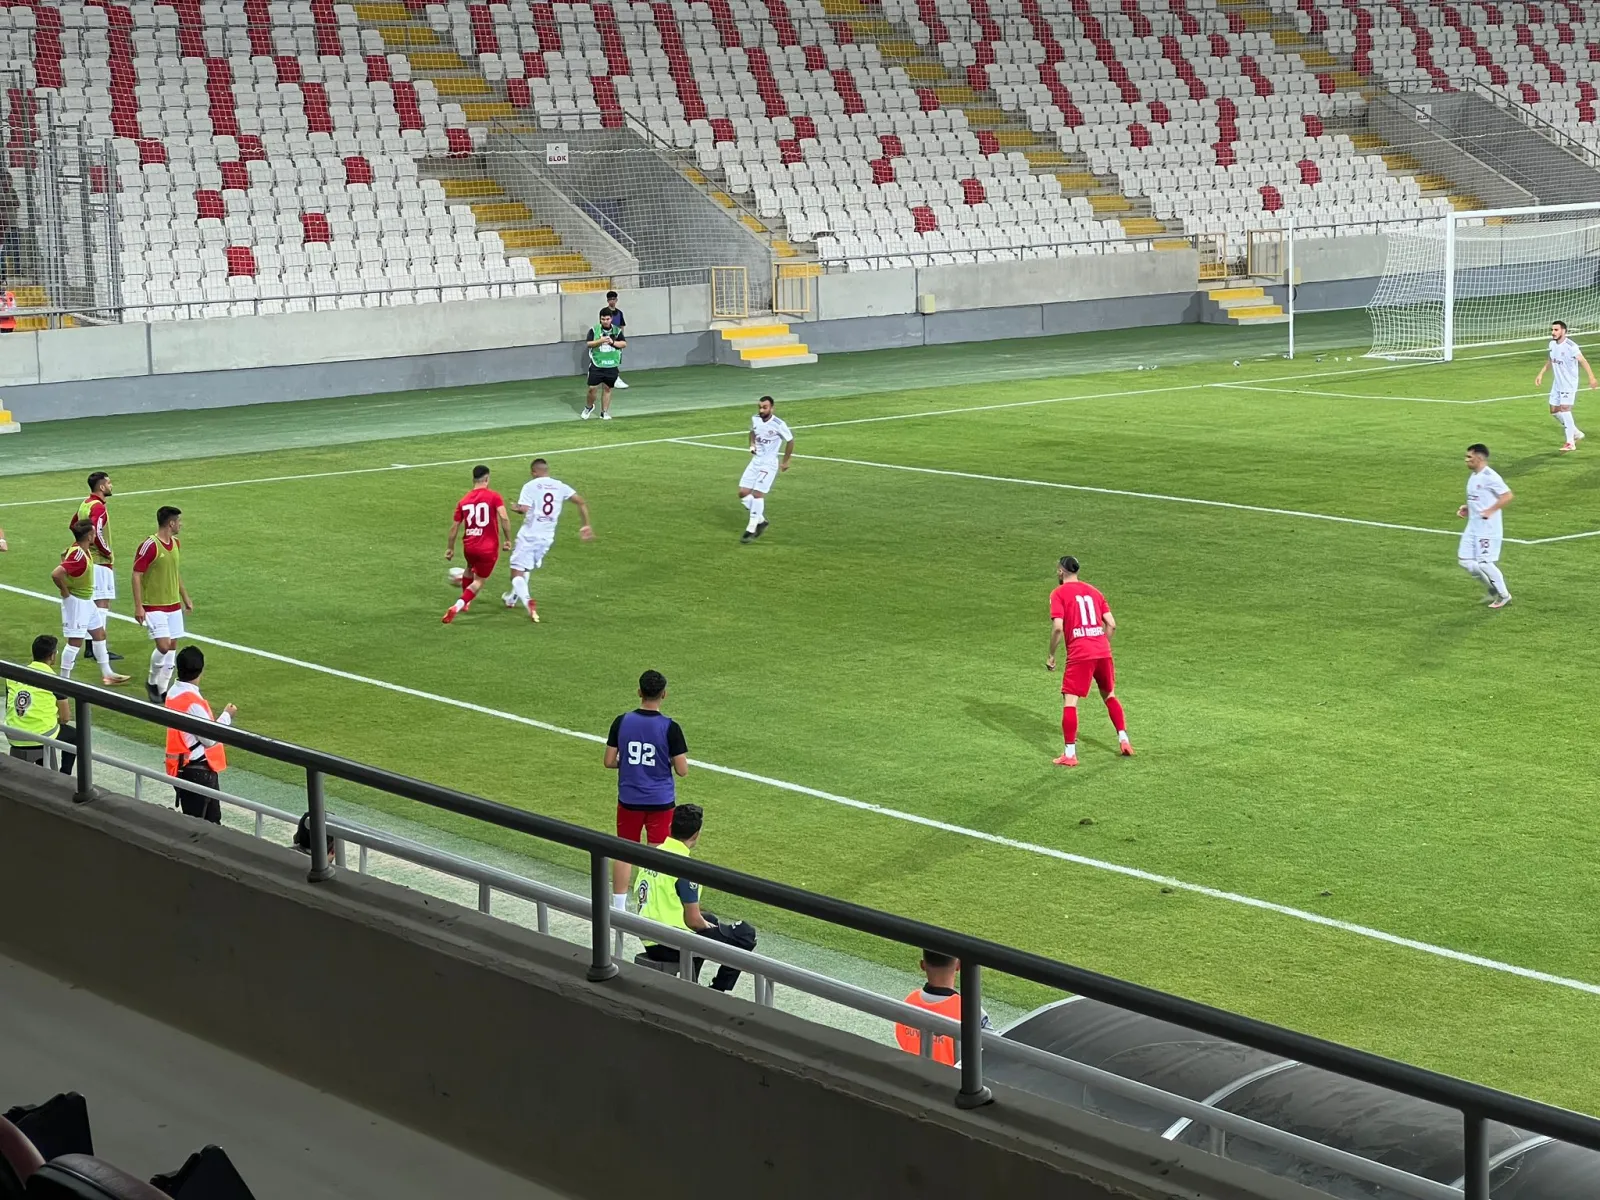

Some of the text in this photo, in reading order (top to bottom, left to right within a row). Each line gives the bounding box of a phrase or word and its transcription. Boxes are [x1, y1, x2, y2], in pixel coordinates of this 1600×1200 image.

[462, 502, 490, 527] 70
[542, 492, 554, 516] 8
[1075, 595, 1097, 626] 11
[628, 741, 656, 767] 92
